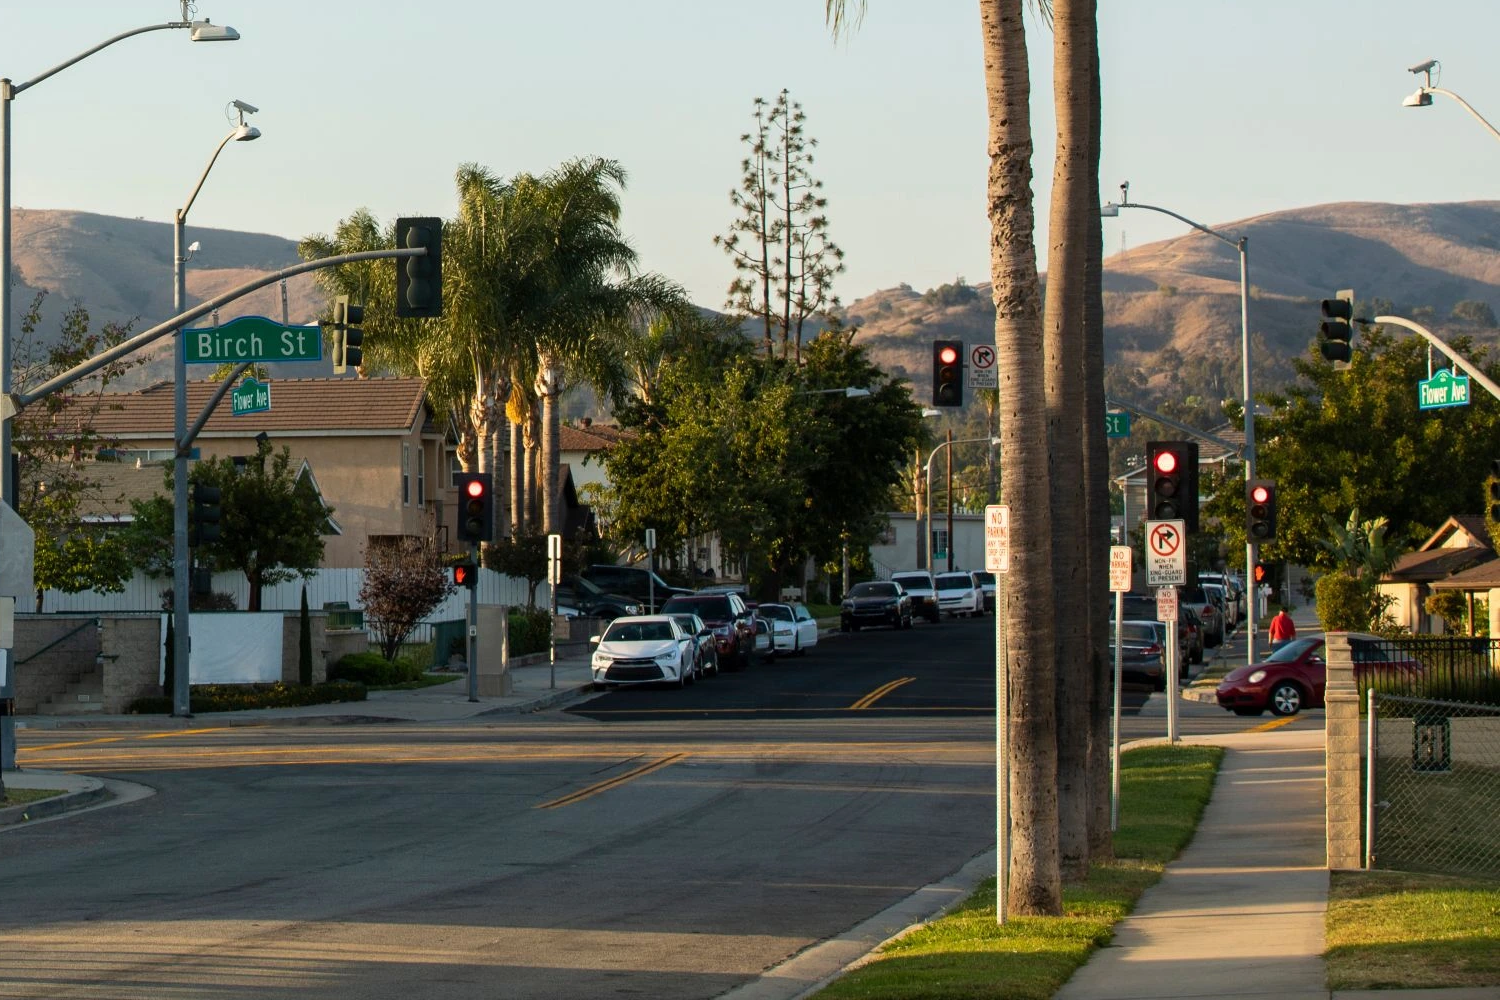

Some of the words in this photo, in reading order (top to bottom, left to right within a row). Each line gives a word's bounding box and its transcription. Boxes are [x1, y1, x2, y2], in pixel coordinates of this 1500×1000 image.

[198, 332, 263, 358] Birch
[281, 331, 306, 356] St
[233, 392, 253, 411] Flower
[256, 388, 268, 408] Ave
[1421, 384, 1448, 405] Flower
[1451, 381, 1466, 402] Ave
[992, 512, 1003, 525] NO
[987, 526, 1006, 538] PARKING
[1113, 551, 1124, 560] NO
[1111, 561, 1129, 569] ARKING
